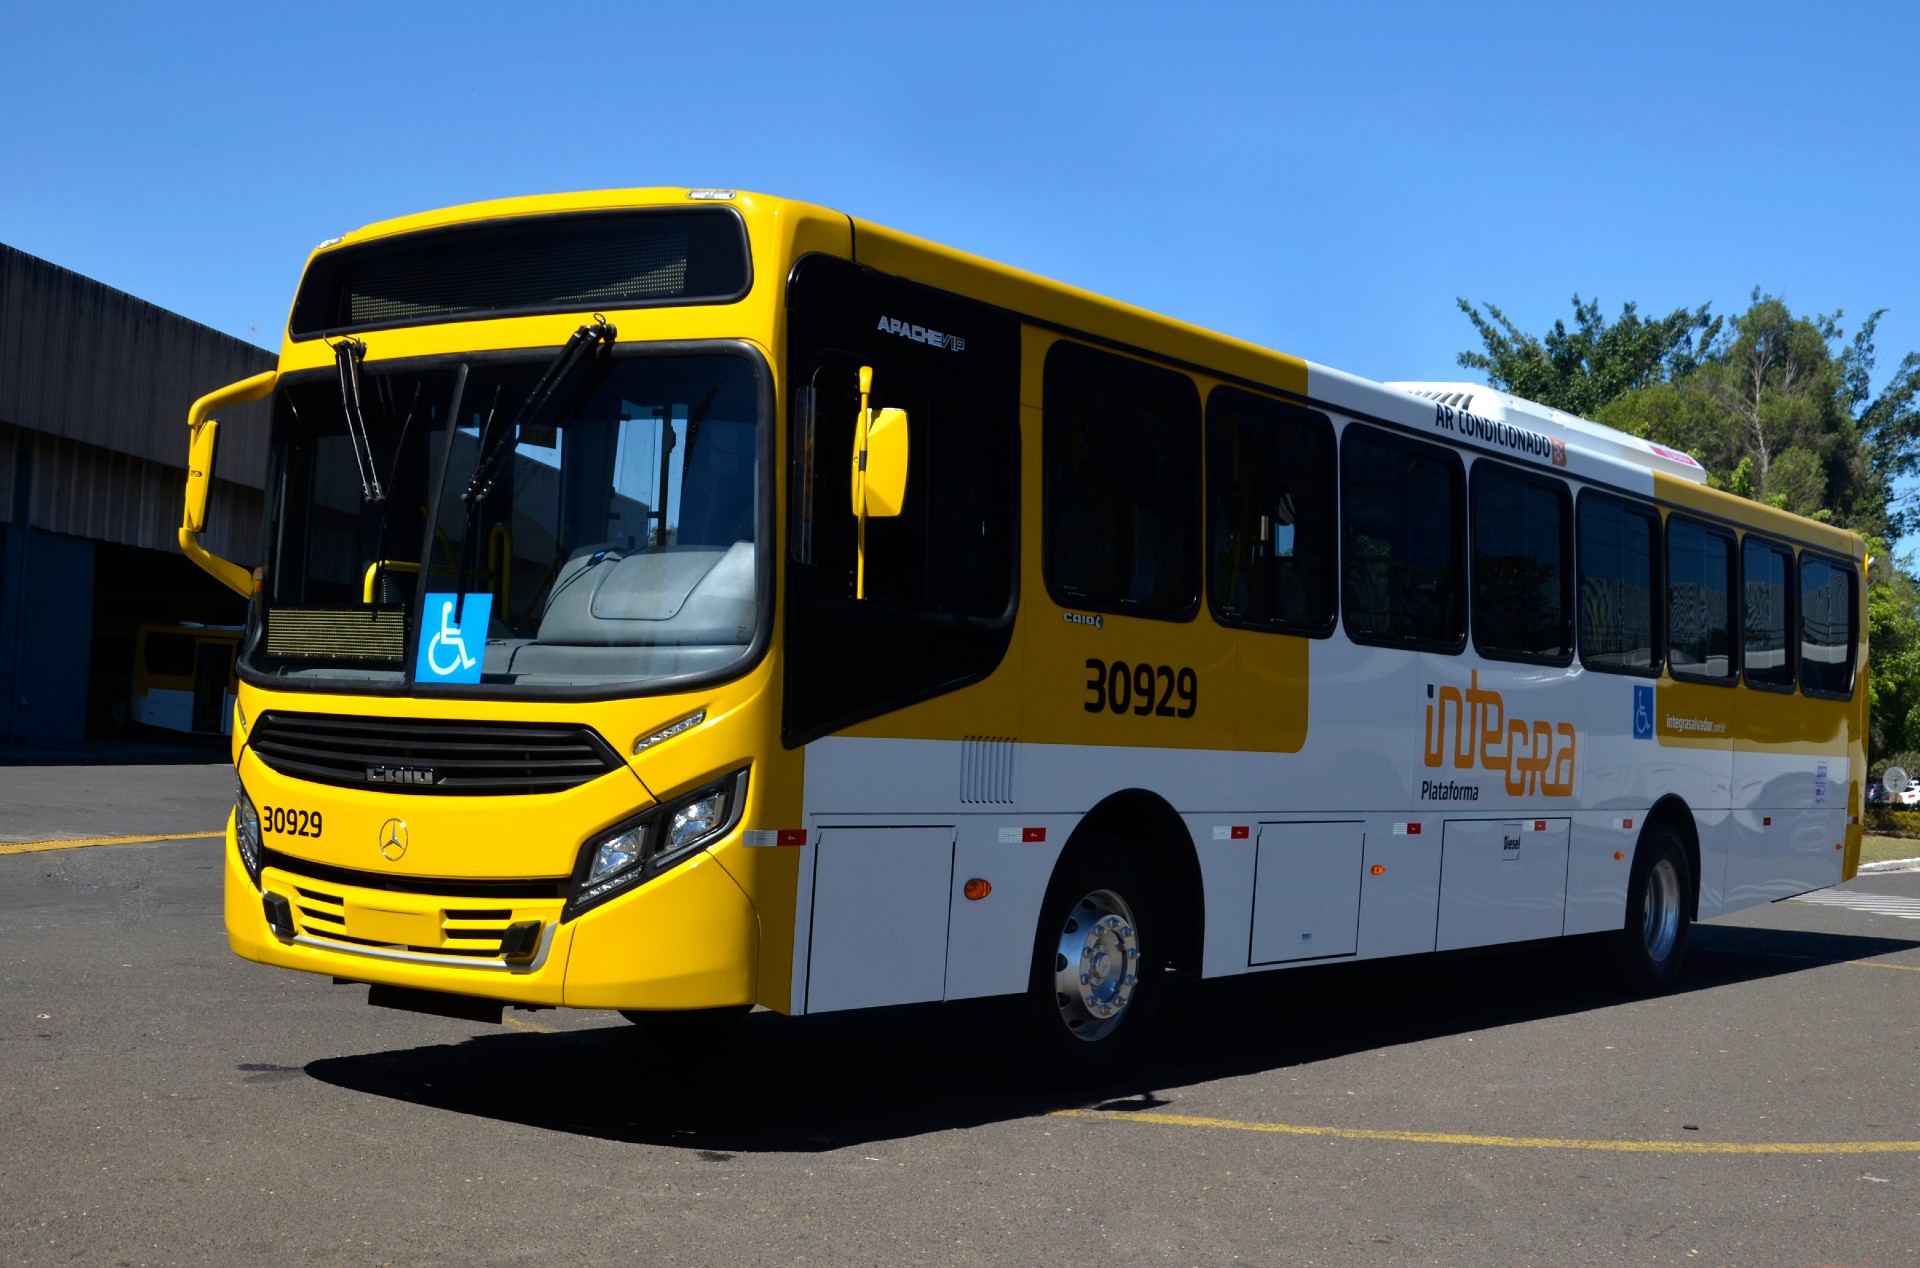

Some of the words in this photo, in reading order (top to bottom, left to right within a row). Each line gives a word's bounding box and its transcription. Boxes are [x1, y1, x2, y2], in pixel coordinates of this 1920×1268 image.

[1435, 402, 1455, 431] AR
[1458, 410, 1552, 458] CONDICIONADO
[1063, 613, 1096, 625] CAIO
[1084, 658, 1198, 719] 30929
[1421, 780, 1479, 801] Plataforma
[263, 805, 323, 838] 30929
[1503, 835, 1521, 850] Diesel
